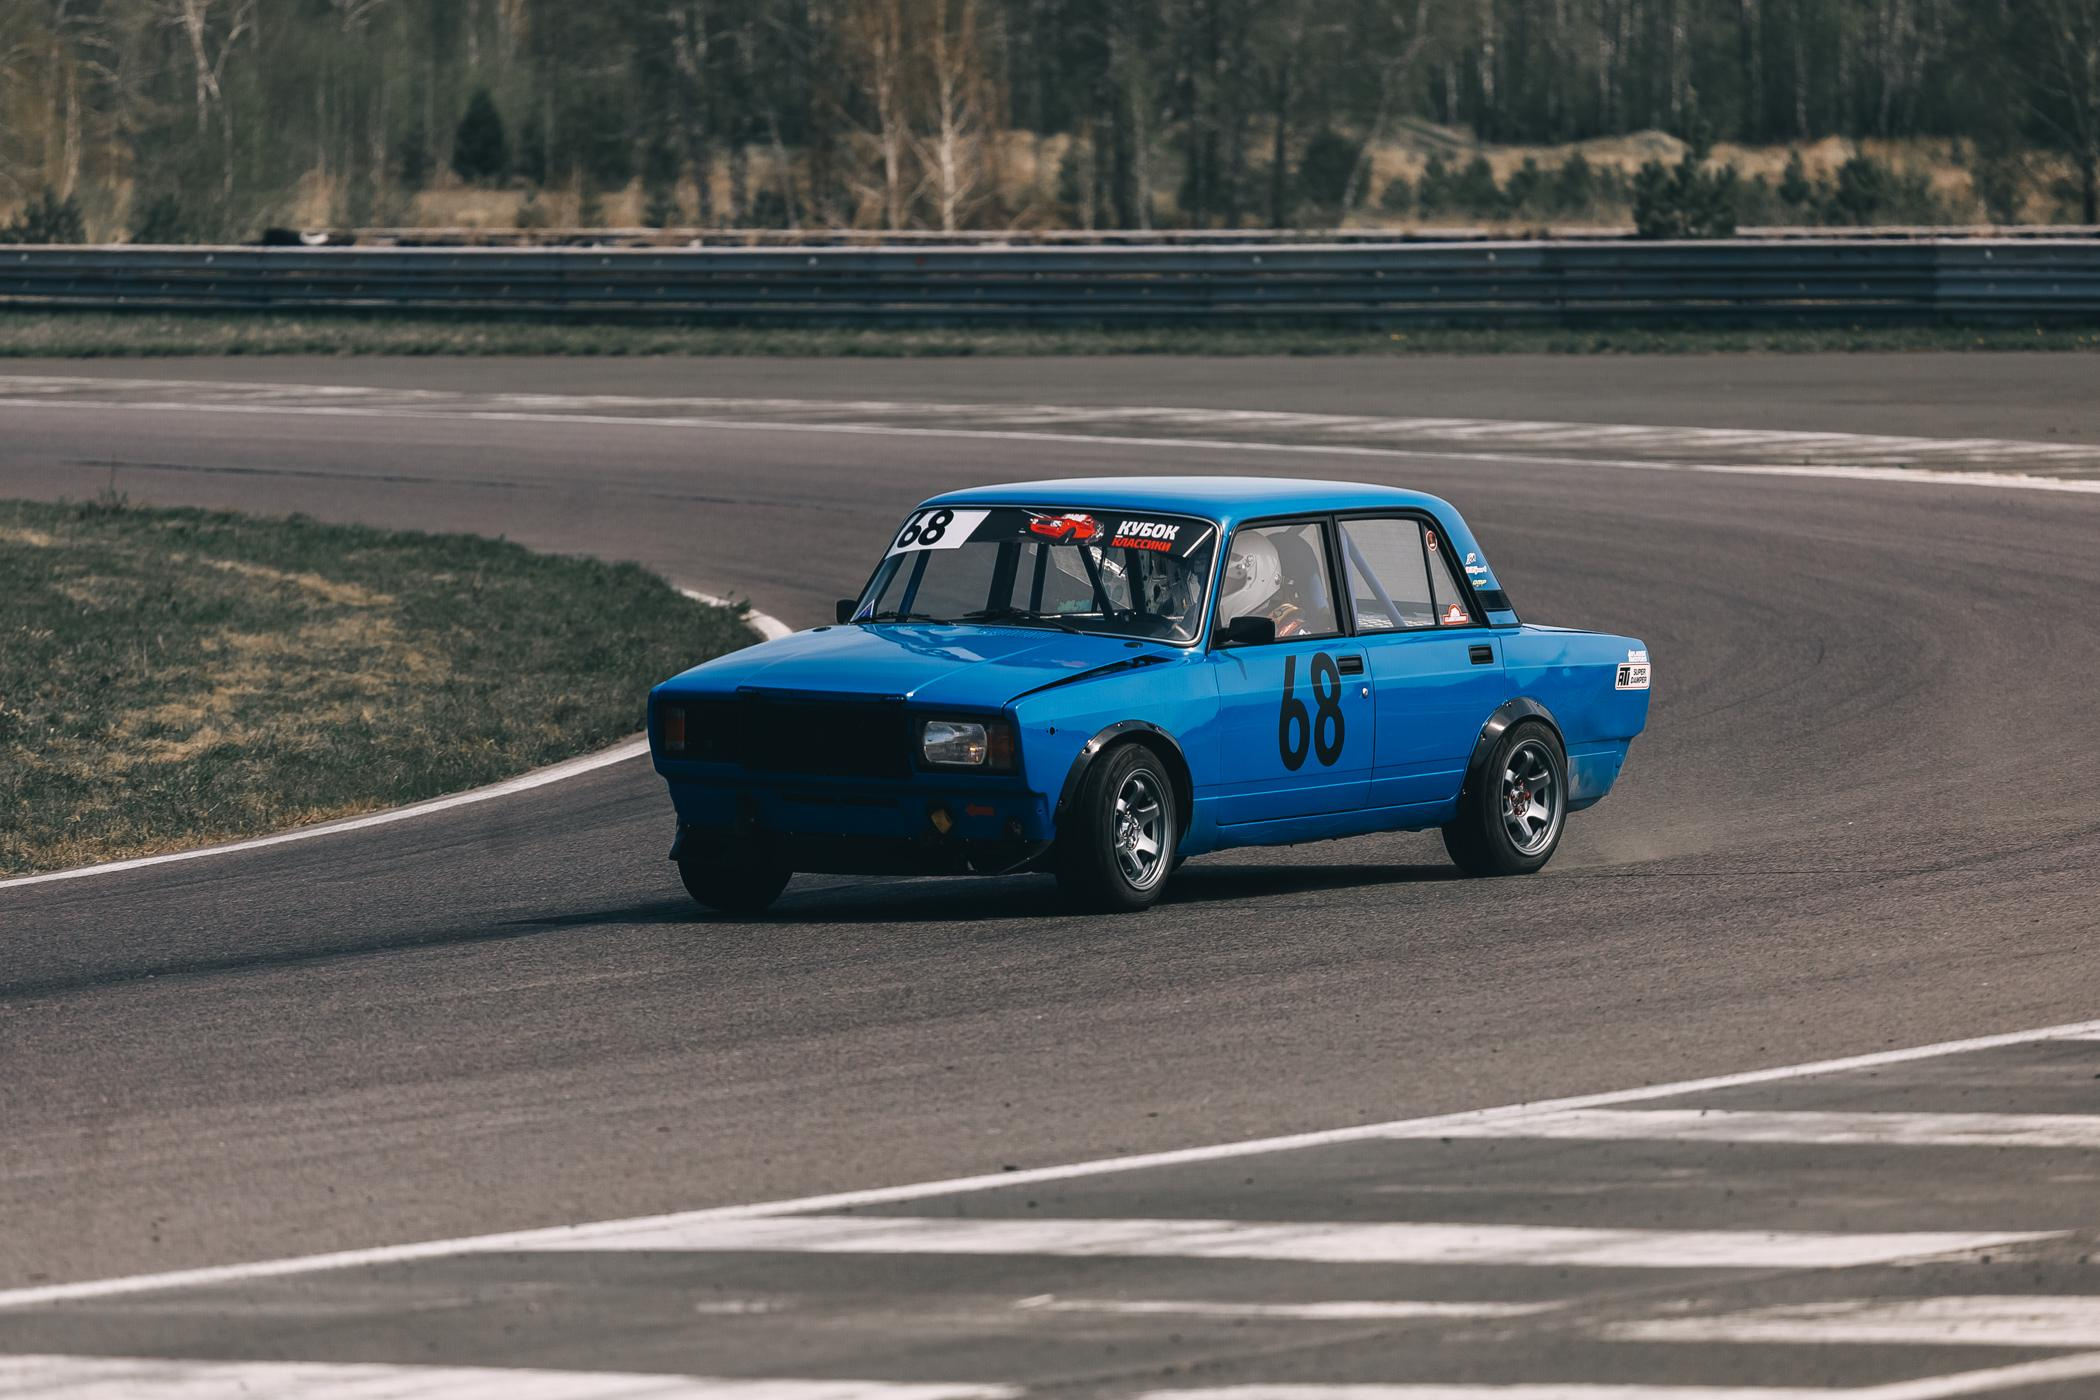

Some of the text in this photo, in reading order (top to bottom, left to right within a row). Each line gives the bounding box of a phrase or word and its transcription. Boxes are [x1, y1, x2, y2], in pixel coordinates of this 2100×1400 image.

[897, 509, 955, 548] 68
[1116, 520, 1180, 540] КУБОК
[1111, 536, 1172, 553] КЛАССИКИ
[1617, 667, 1631, 687] ATI
[1630, 676, 1648, 684] DAMPER
[1633, 668, 1647, 676] SUPER
[1278, 652, 1345, 772] 68
